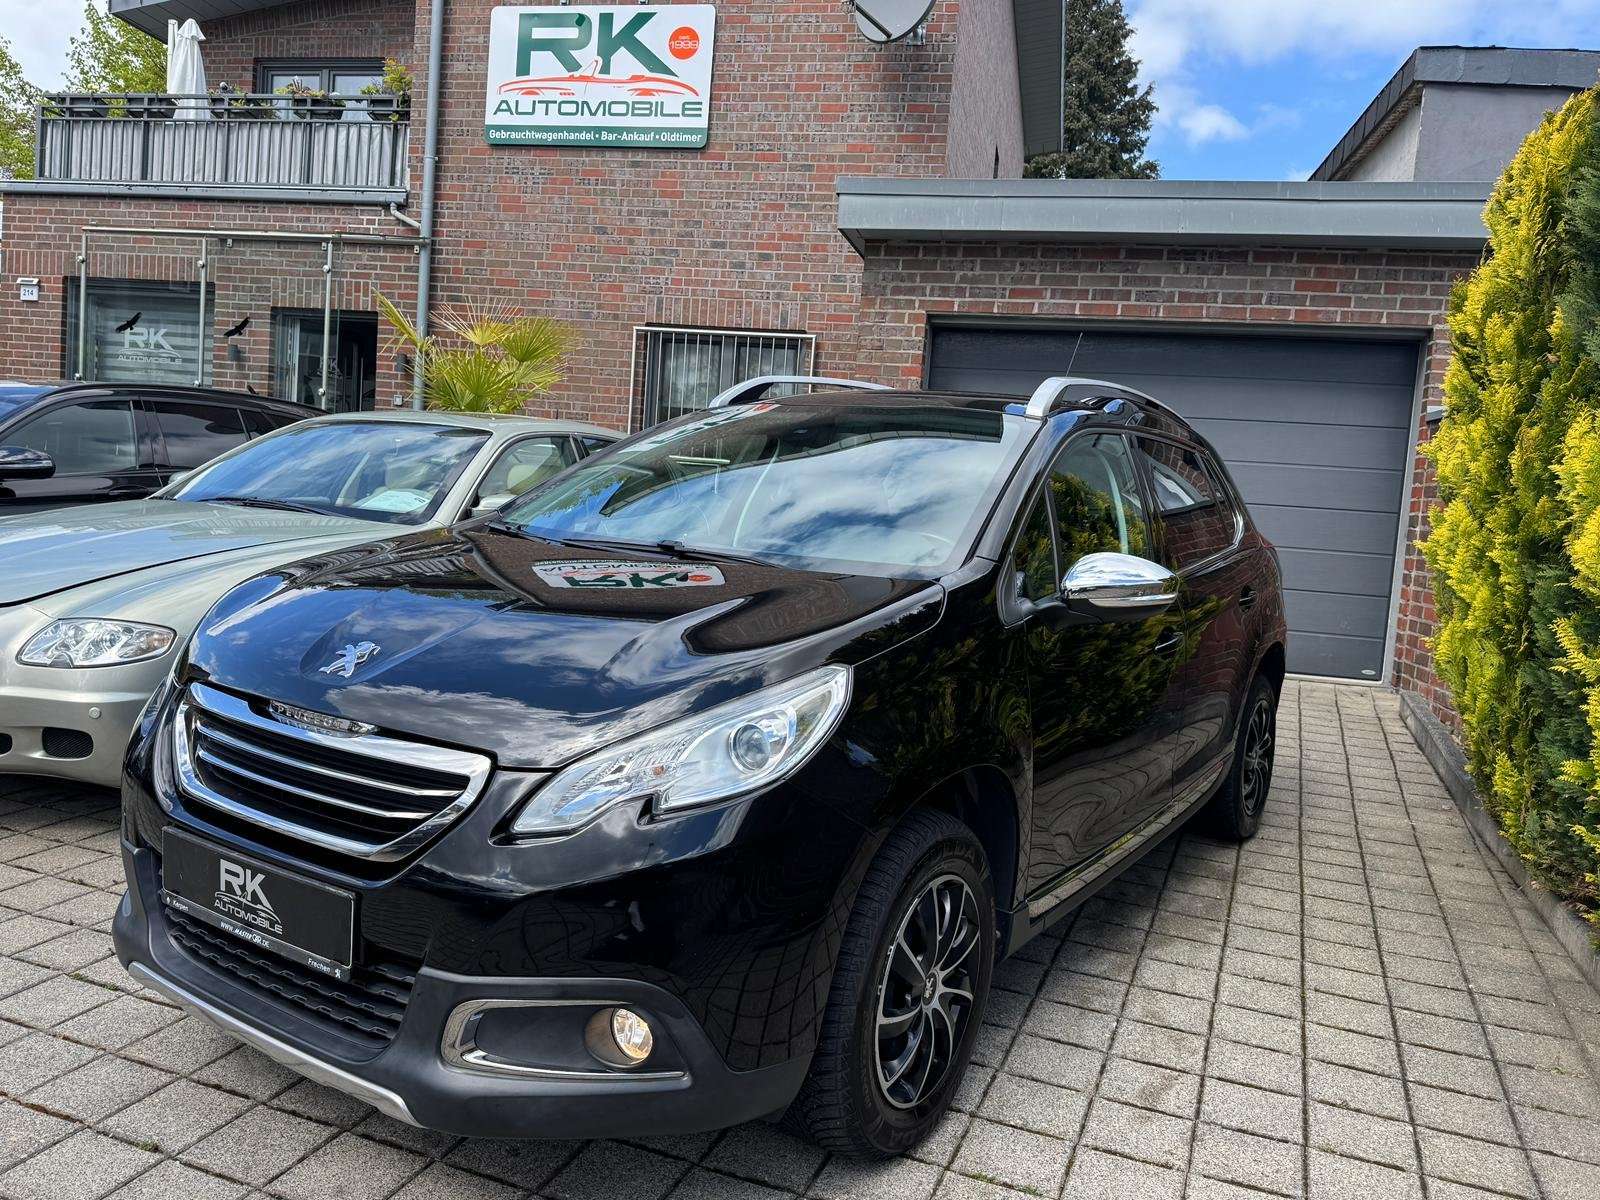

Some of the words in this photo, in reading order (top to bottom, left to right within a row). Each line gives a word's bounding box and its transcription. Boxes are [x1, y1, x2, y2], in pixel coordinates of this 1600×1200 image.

[516, 12, 679, 77] RK
[493, 99, 702, 118] AUTOMOBILE
[489, 129, 594, 141] Gebrauchtwagenhandel
[601, 131, 655, 142] Bar-Ankauf
[660, 132, 702, 143] Oldtimer
[22, 289, 34, 297] 214
[124, 327, 176, 351] RK
[220, 858, 274, 912] RK
[214, 900, 283, 935] AUTOMOBILE
[307, 958, 331, 974] Frechen
